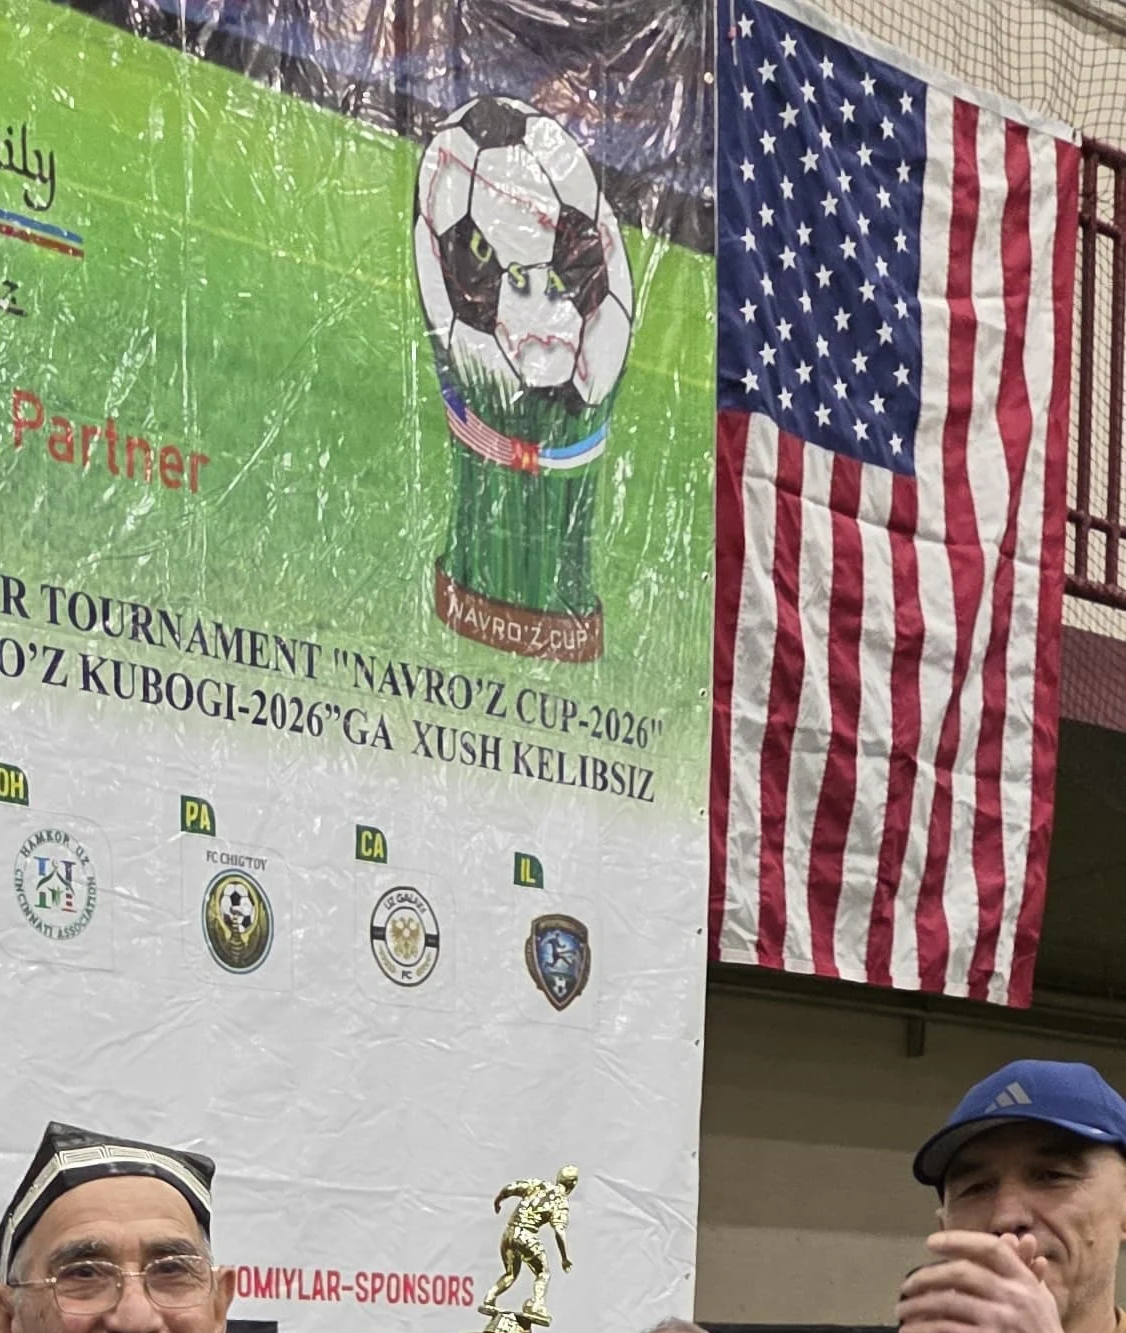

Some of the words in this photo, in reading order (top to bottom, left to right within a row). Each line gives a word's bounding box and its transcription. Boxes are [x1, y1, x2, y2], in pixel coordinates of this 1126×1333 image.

[12, 388, 211, 494] Partner
[40, 583, 322, 680] TOURNAMENT
[549, 629, 588, 650] CUP
[411, 719, 504, 772] XUSH
[512, 739, 656, 803] KELIBSIZ
[185, 801, 212, 832] PA
[20, 830, 71, 859] HAMKOR
[206, 850, 219, 864] FC
[361, 830, 385, 859] CA
[520, 857, 537, 884] IL
[236, 1264, 474, 1307] OMIYLAR-SPONSORS
